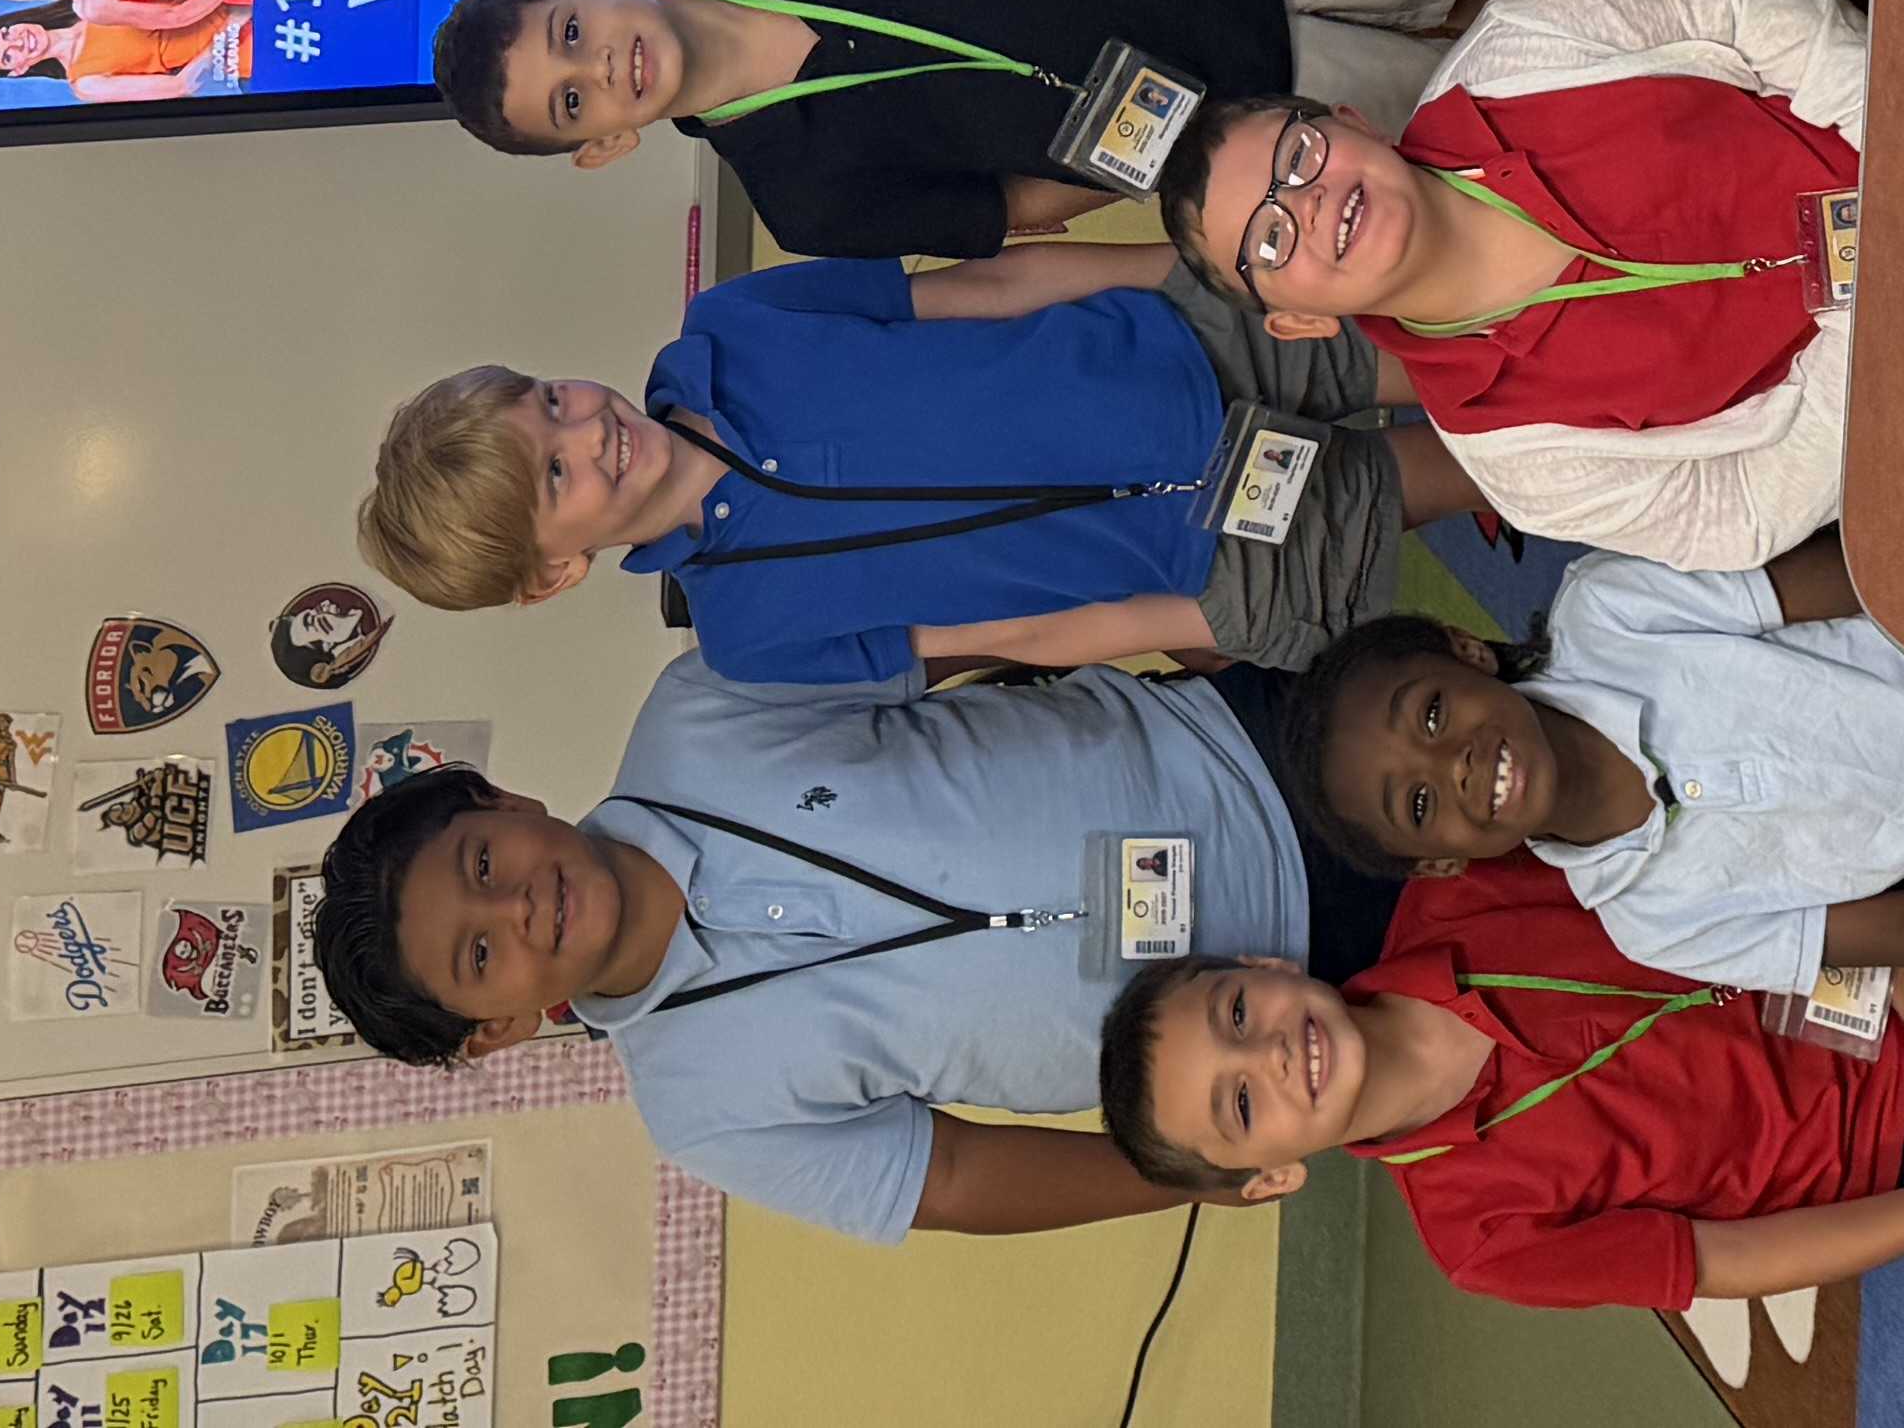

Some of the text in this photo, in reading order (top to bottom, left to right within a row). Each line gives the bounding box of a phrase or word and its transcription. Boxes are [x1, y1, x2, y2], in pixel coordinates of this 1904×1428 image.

[95, 630, 124, 723] FLORIDA
[312, 714, 349, 800] WARRIORS
[162, 772, 198, 852] UCF
[234, 771, 269, 817] GOLDEN
[46, 902, 107, 1010] Dodgers
[298, 1027, 317, 1036] I
[3, 1303, 39, 1367] Sunday
[48, 1290, 87, 1349] Day
[83, 1297, 106, 1334] 12
[110, 1300, 136, 1341] 9/26
[200, 1297, 246, 1365] Day
[240, 1322, 268, 1357] 17
